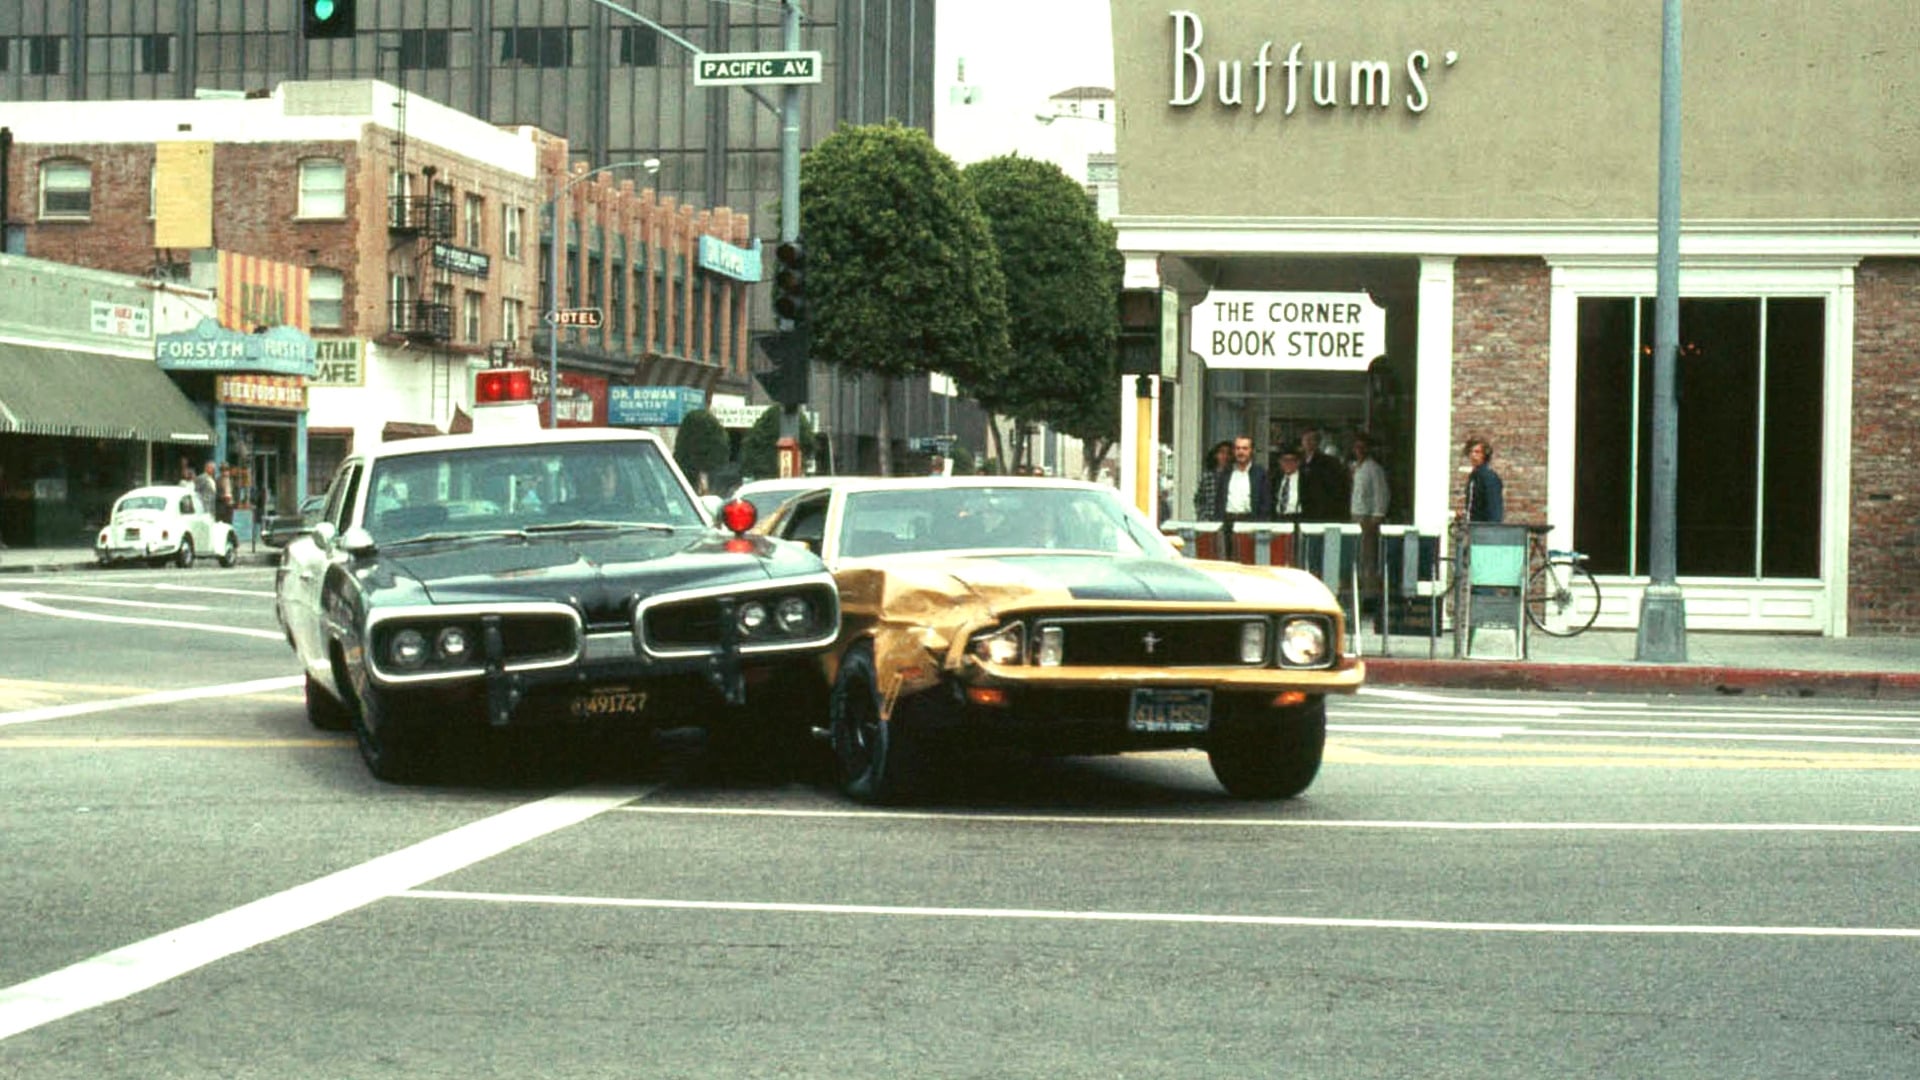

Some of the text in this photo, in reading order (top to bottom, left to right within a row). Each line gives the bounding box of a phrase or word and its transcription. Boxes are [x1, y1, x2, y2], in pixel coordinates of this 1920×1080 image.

[704, 60, 809, 76] PACIFIC AV.
[1168, 9, 1458, 114] Buffums'
[1213, 302, 1362, 324] THE CORNER
[157, 341, 244, 358] FORSYTH
[1212, 330, 1365, 358] BOOK STORE
[633, 389, 677, 400] ROWAN
